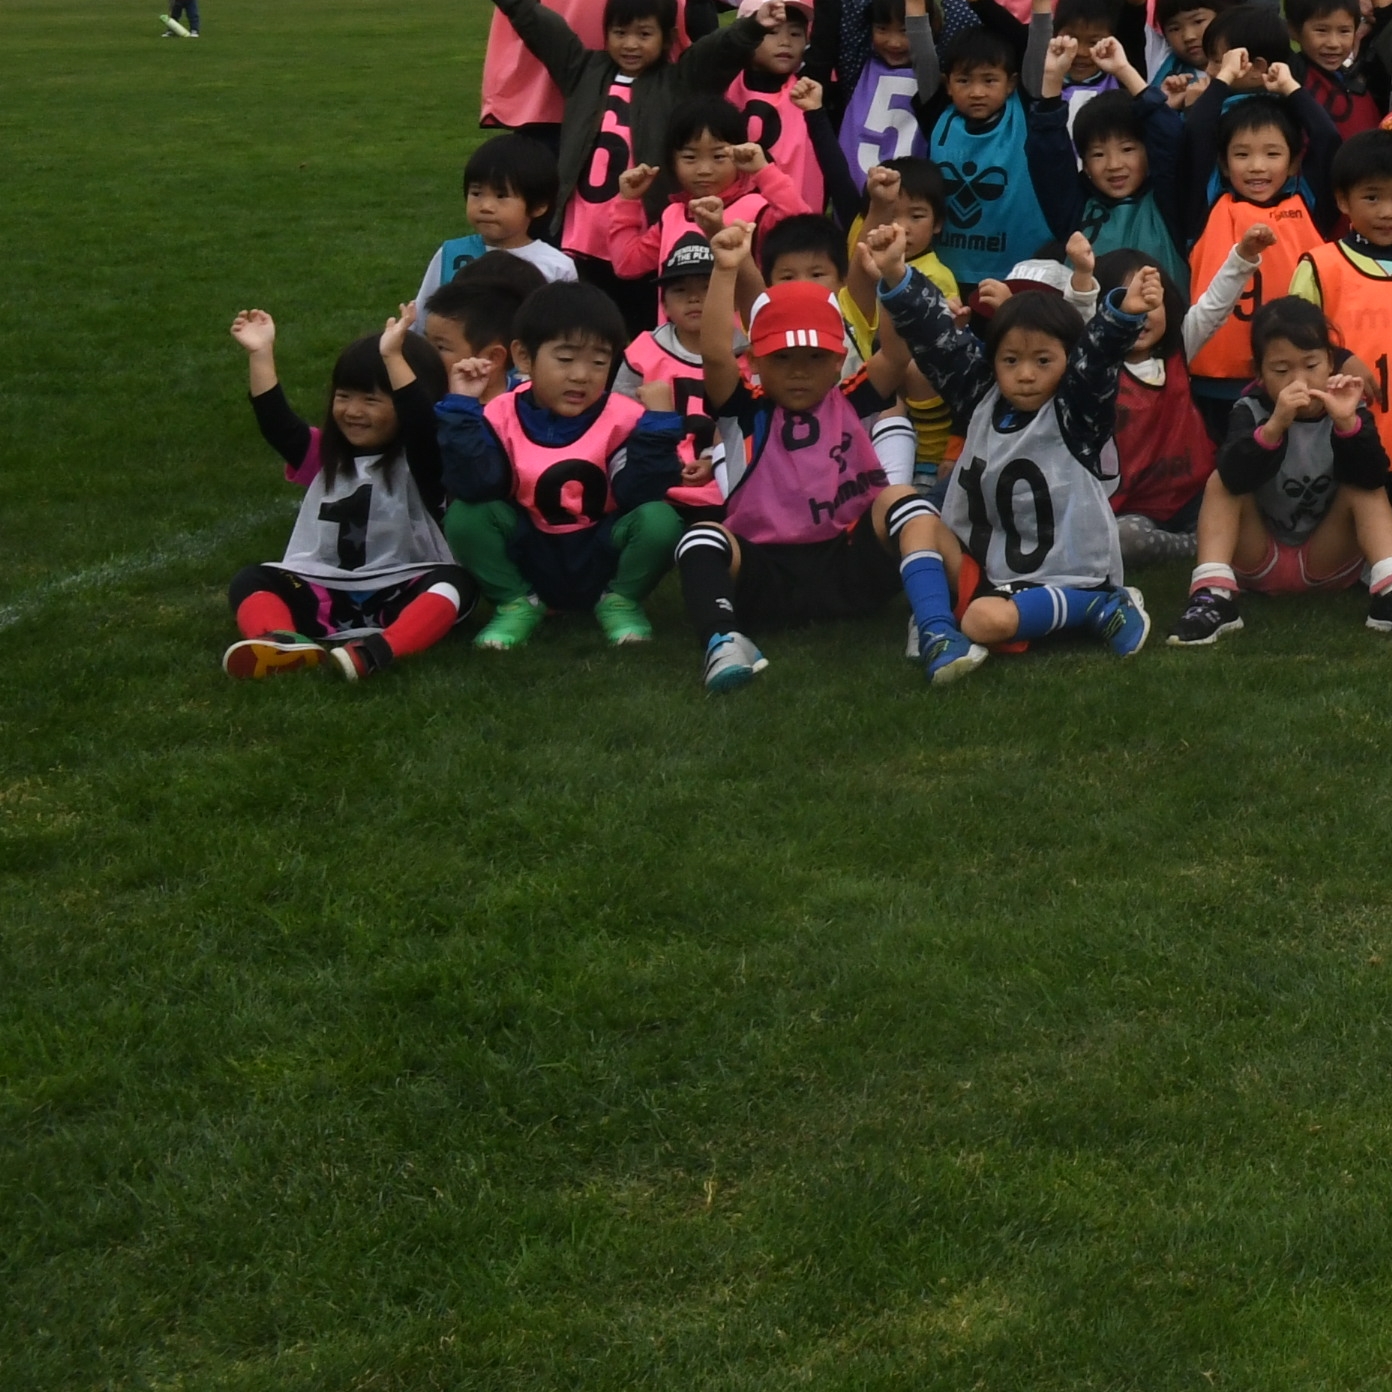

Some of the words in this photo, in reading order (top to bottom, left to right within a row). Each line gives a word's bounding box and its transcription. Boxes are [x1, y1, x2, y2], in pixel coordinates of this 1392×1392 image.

[857, 75, 919, 175] 5
[318, 483, 373, 572] 1
[958, 456, 1055, 574] 10
